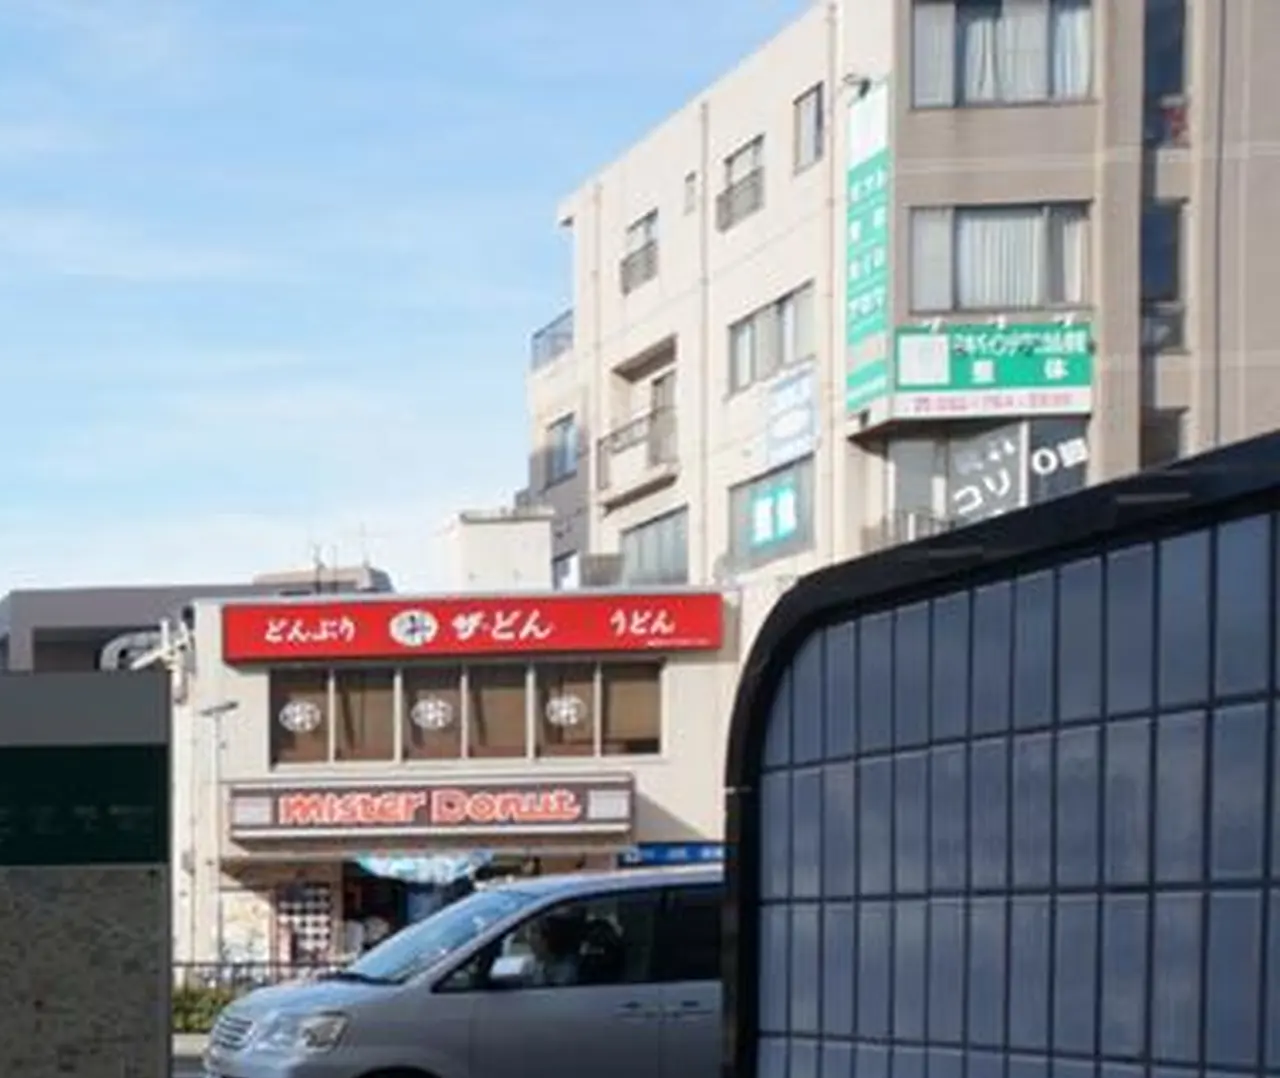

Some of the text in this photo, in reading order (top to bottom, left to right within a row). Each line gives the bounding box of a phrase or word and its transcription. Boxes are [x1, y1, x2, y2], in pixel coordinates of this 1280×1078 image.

[263, 615, 355, 643] どんぶり
[608, 608, 677, 636] うどん
[431, 788, 582, 822] Donut
